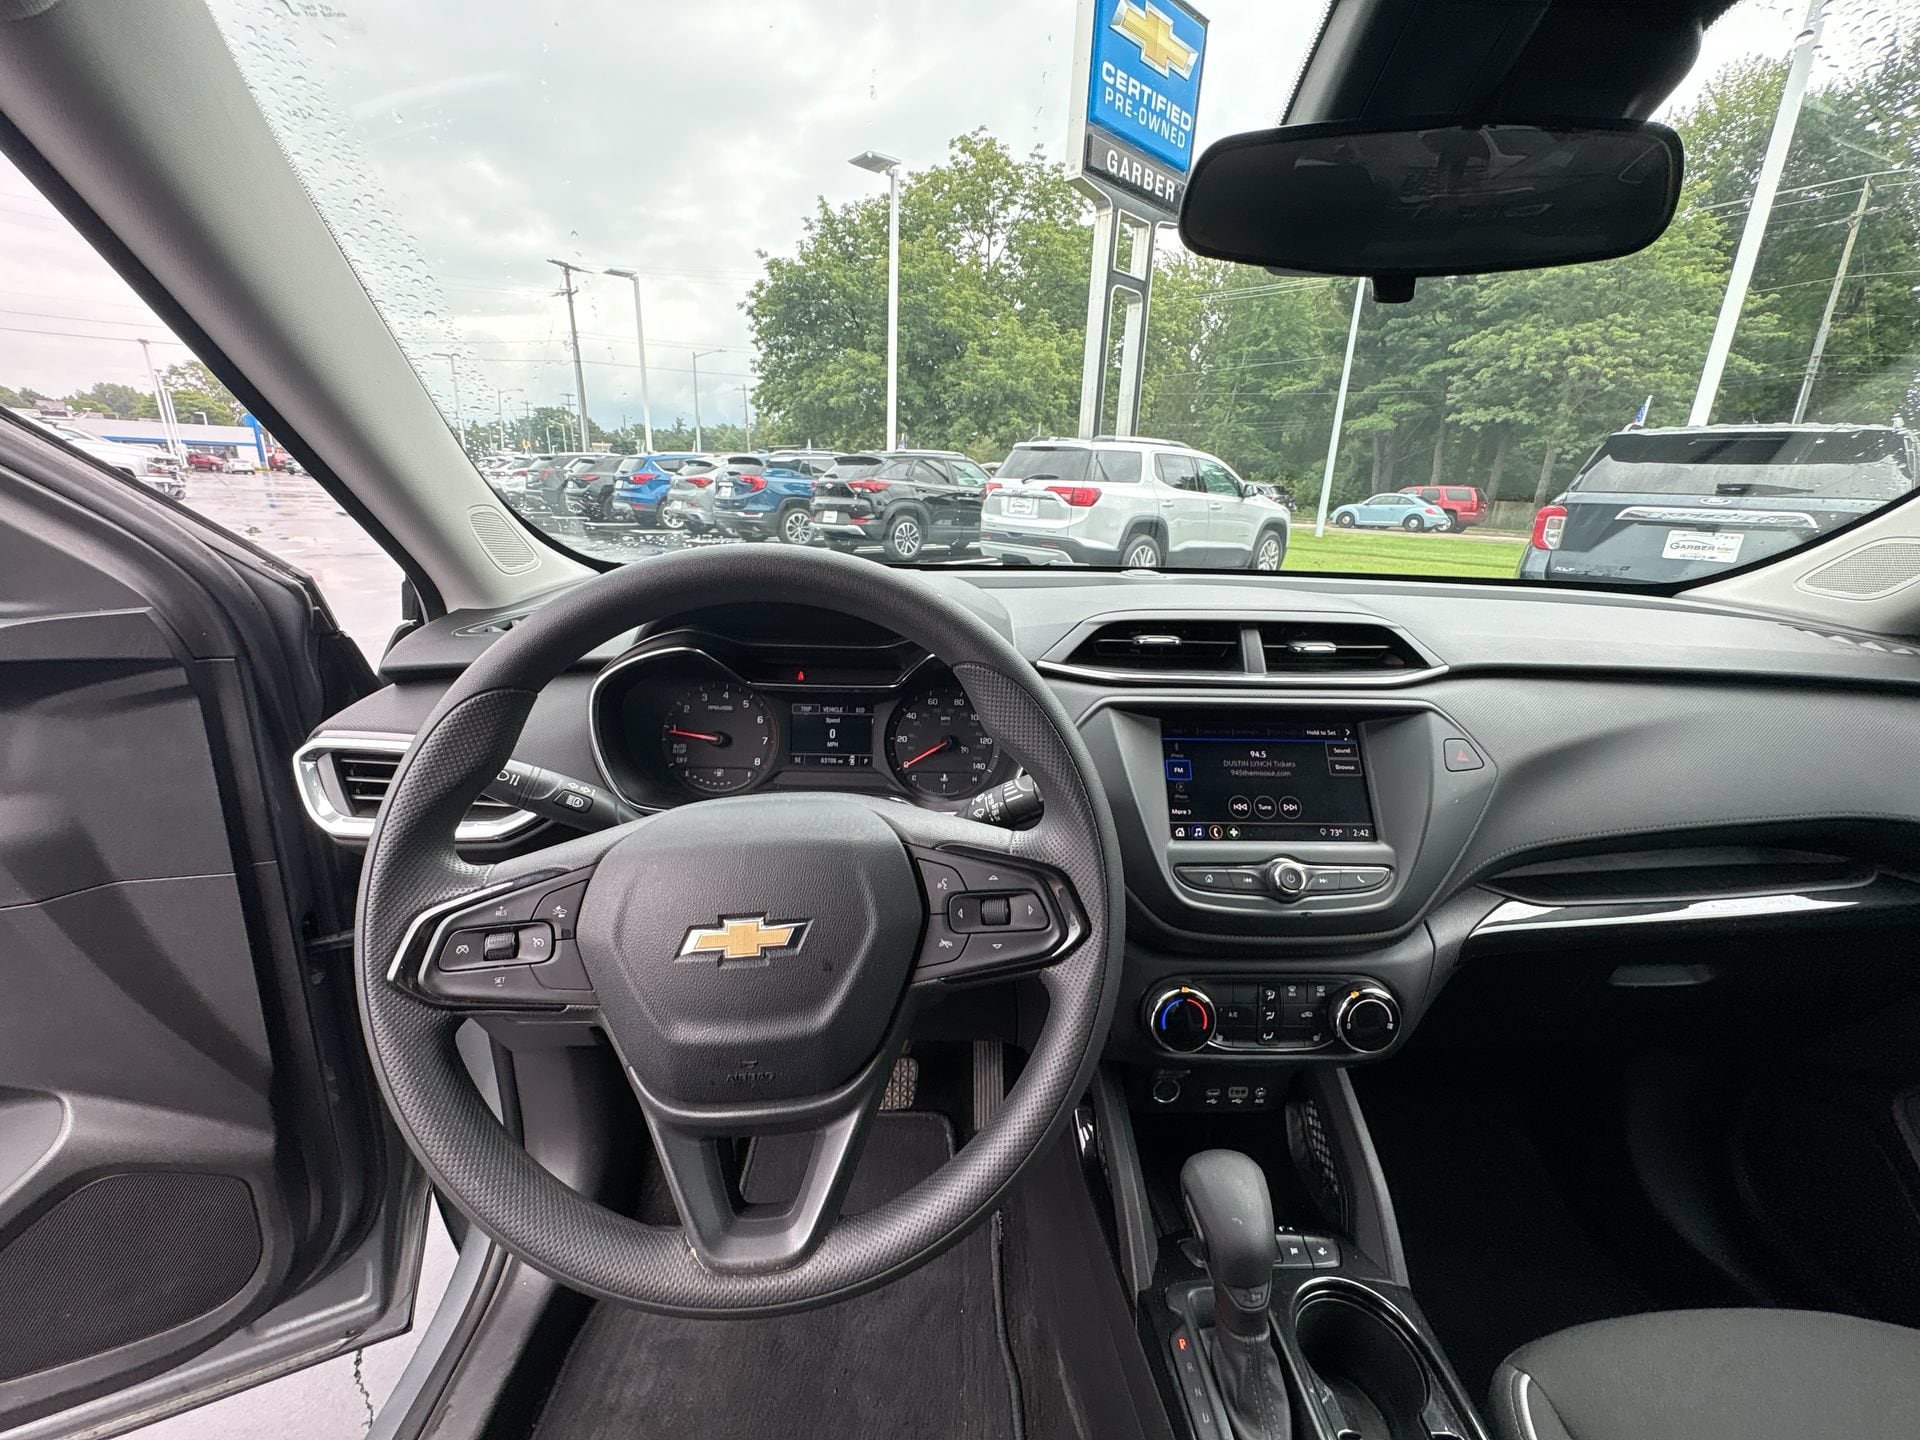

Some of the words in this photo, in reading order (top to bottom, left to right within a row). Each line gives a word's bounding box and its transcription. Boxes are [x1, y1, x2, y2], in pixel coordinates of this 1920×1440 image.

[1101, 61, 1192, 132] CERTIFIED
[1104, 87, 1186, 149] PRE-OWNED
[1106, 149, 1176, 203] GARBER
[1670, 542, 1715, 551] GARBER
[701, 693, 708, 701] 3
[722, 691, 729, 699] 4
[742, 700, 750, 708] 5
[683, 705, 690, 713] 2
[757, 716, 764, 724] 6
[906, 712, 917, 720] 40
[829, 728, 836, 739] 0
[762, 736, 769, 745] 7
[896, 735, 908, 743] 20
[1249, 750, 1267, 758] 94.5
[754, 758, 761, 766] 8
[1273, 760, 1296, 768] Tickets
[1230, 769, 1291, 777] 945themoose.com
[1352, 828, 1369, 837] 2:42
[494, 976, 505, 984] SET
[1178, 1338, 1187, 1351] P
[1186, 1361, 1195, 1373] R
